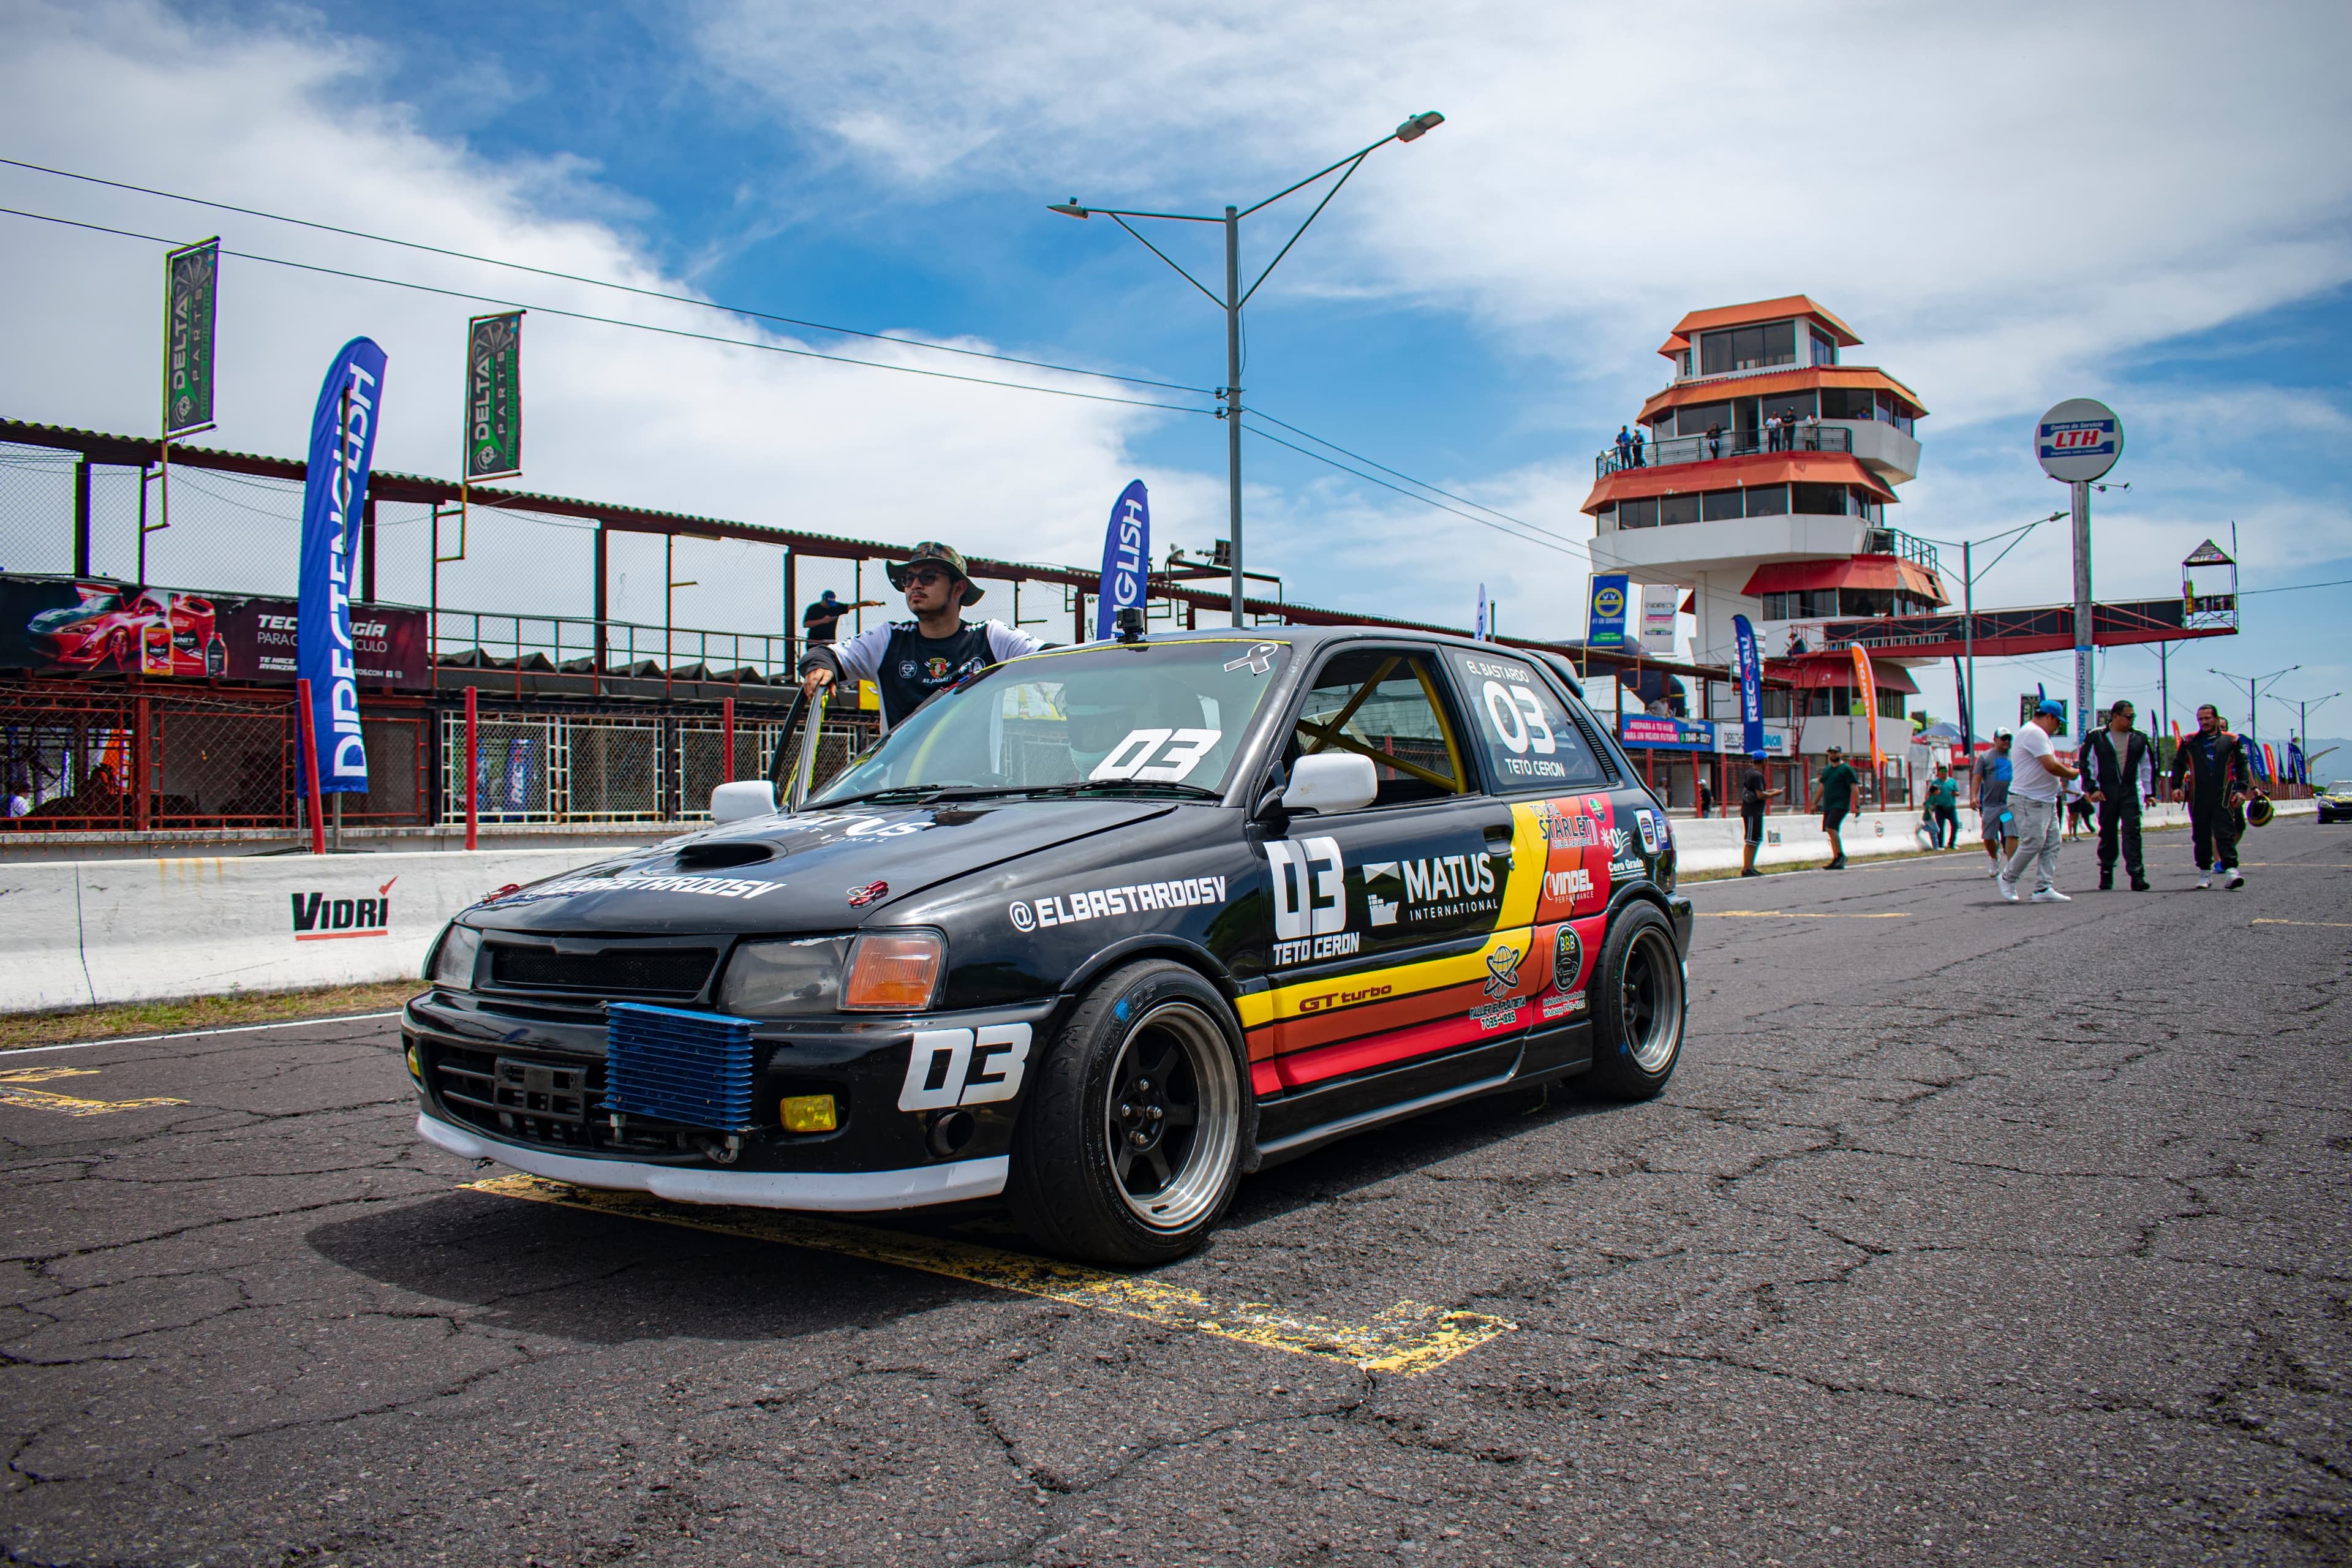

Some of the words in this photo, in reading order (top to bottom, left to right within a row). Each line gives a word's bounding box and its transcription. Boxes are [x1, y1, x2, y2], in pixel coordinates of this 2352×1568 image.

[173, 295, 189, 390] DELTA
[192, 288, 203, 381] PART'S
[475, 356, 490, 441] DELTA
[496, 351, 506, 434] PART'S
[2055, 429, 2100, 448] LTH
[257, 631, 290, 646] PARA
[1466, 660, 1481, 675] EL
[1479, 662, 1529, 683] BASTARDO
[1482, 680, 1556, 754] 03
[1630, 722, 1651, 730] PREPARA
[1624, 731, 1636, 740] PARA
[1645, 732, 1660, 741] MEJOR
[1660, 732, 1678, 741] FUTURO
[1088, 728, 1221, 782] 03
[1504, 758, 1532, 775] TETO
[1533, 760, 1566, 777] CERON
[1529, 803, 1562, 818] TOYOTA
[1539, 815, 1591, 841] STARLET
[1402, 852, 1494, 903] MATUS
[1607, 861, 1625, 873] Cero
[1625, 858, 1644, 870] Grado
[1262, 836, 1346, 940] 03
[1555, 891, 1594, 904] PERFORMANCE
[1410, 899, 1498, 921] INTERNATIONAL
[1273, 940, 1311, 966] TETO
[1313, 932, 1360, 959] CERON
[1559, 934, 1575, 952] BBB
[1299, 992, 1339, 1012] GT
[1341, 984, 1392, 1003] turbo
[897, 1022, 1033, 1112] 03
